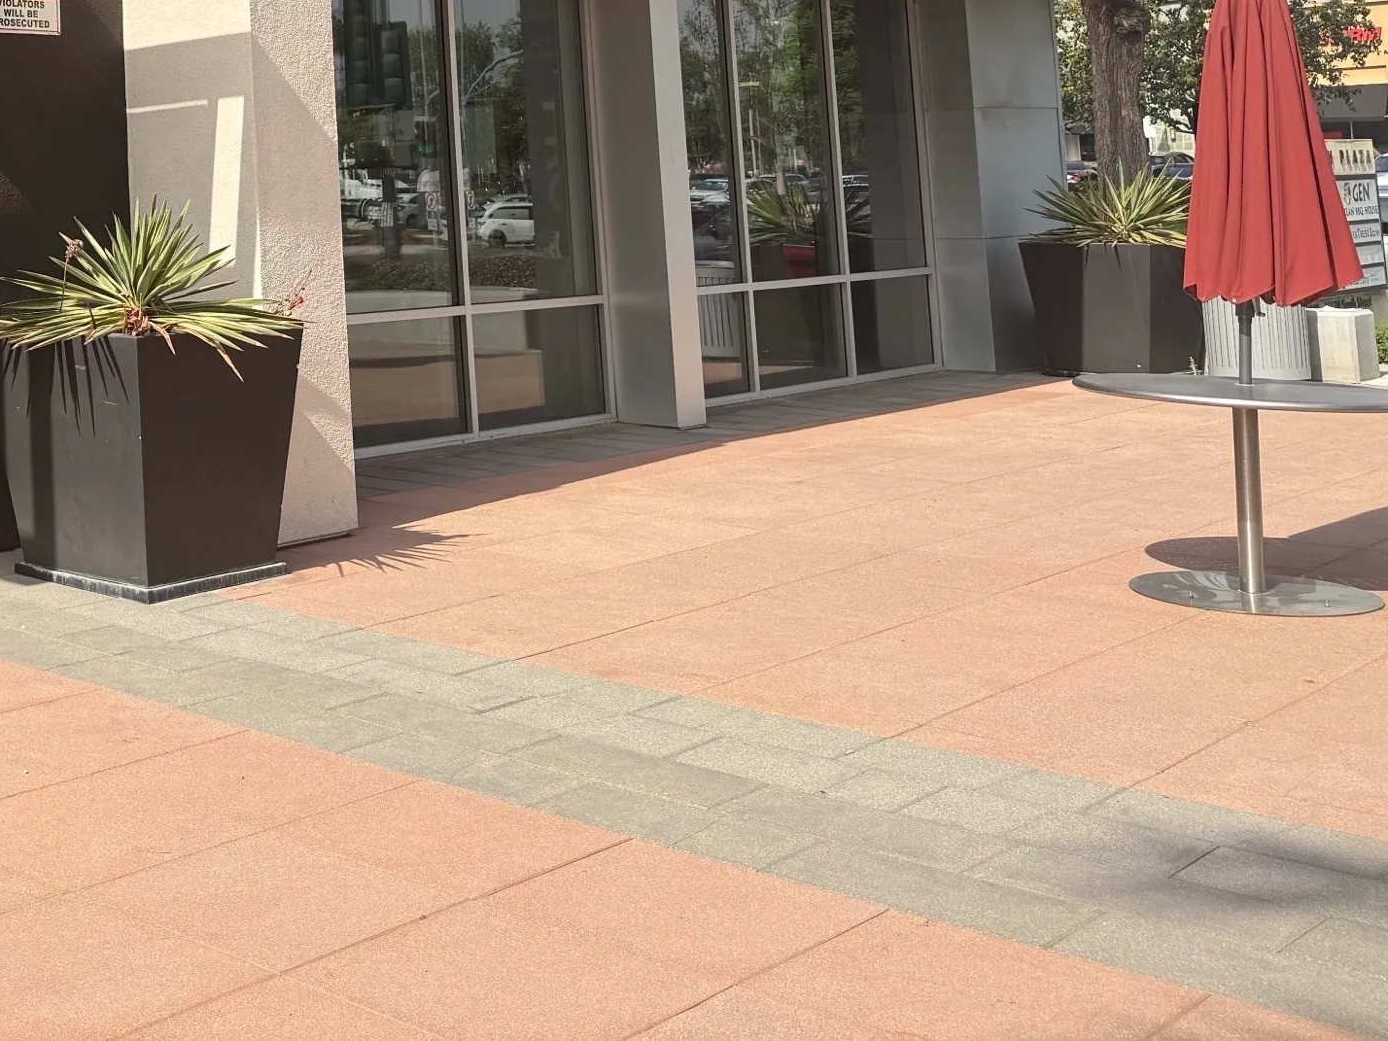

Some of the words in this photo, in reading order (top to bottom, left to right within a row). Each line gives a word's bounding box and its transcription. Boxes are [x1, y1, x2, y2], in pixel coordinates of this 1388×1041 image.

[4, 9, 24, 18] WILL
[27, 10, 38, 18] BE
[1339, 149, 1372, 165] PLAZA
[1352, 182, 1371, 202] GEN
